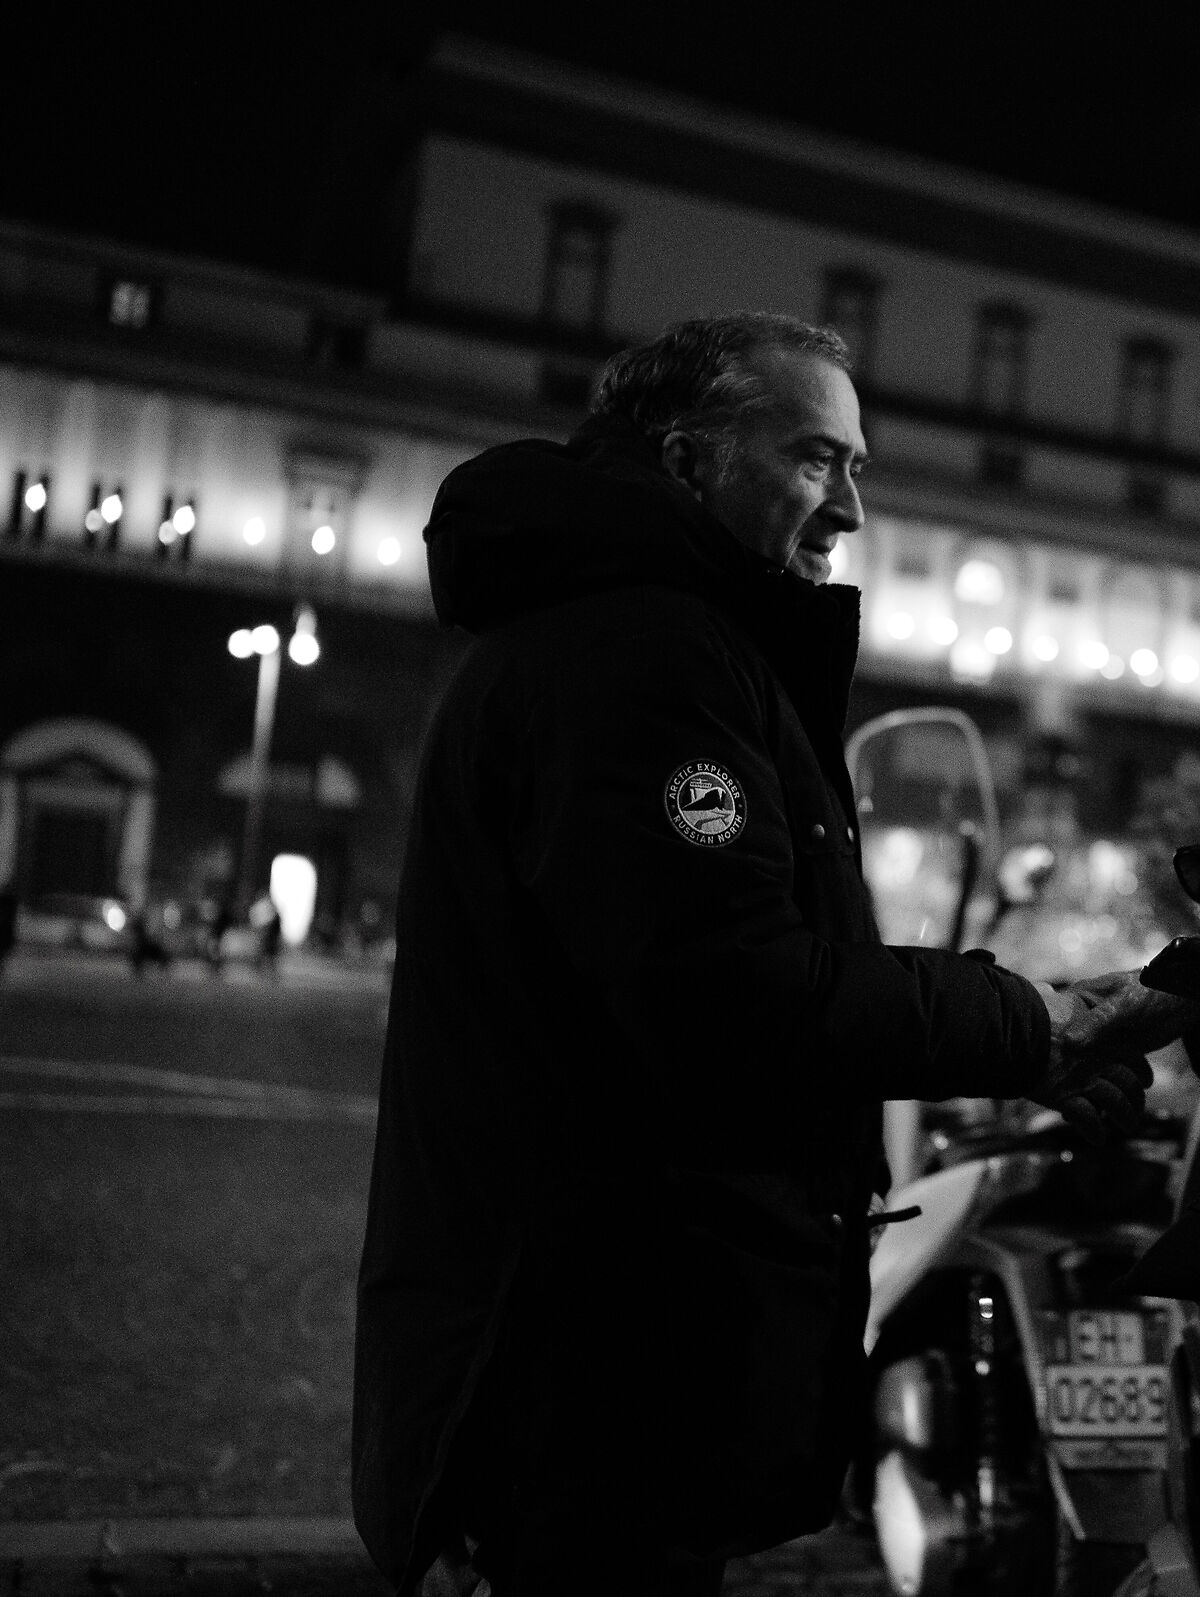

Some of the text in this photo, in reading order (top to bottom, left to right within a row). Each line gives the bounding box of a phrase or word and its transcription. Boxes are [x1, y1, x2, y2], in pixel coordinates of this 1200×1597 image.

[669, 763, 741, 800] ARCTIC EXPLORER
[673, 814, 743, 844] RUSSIAN NORTH
[1050, 1375, 1167, 1424] 02689
